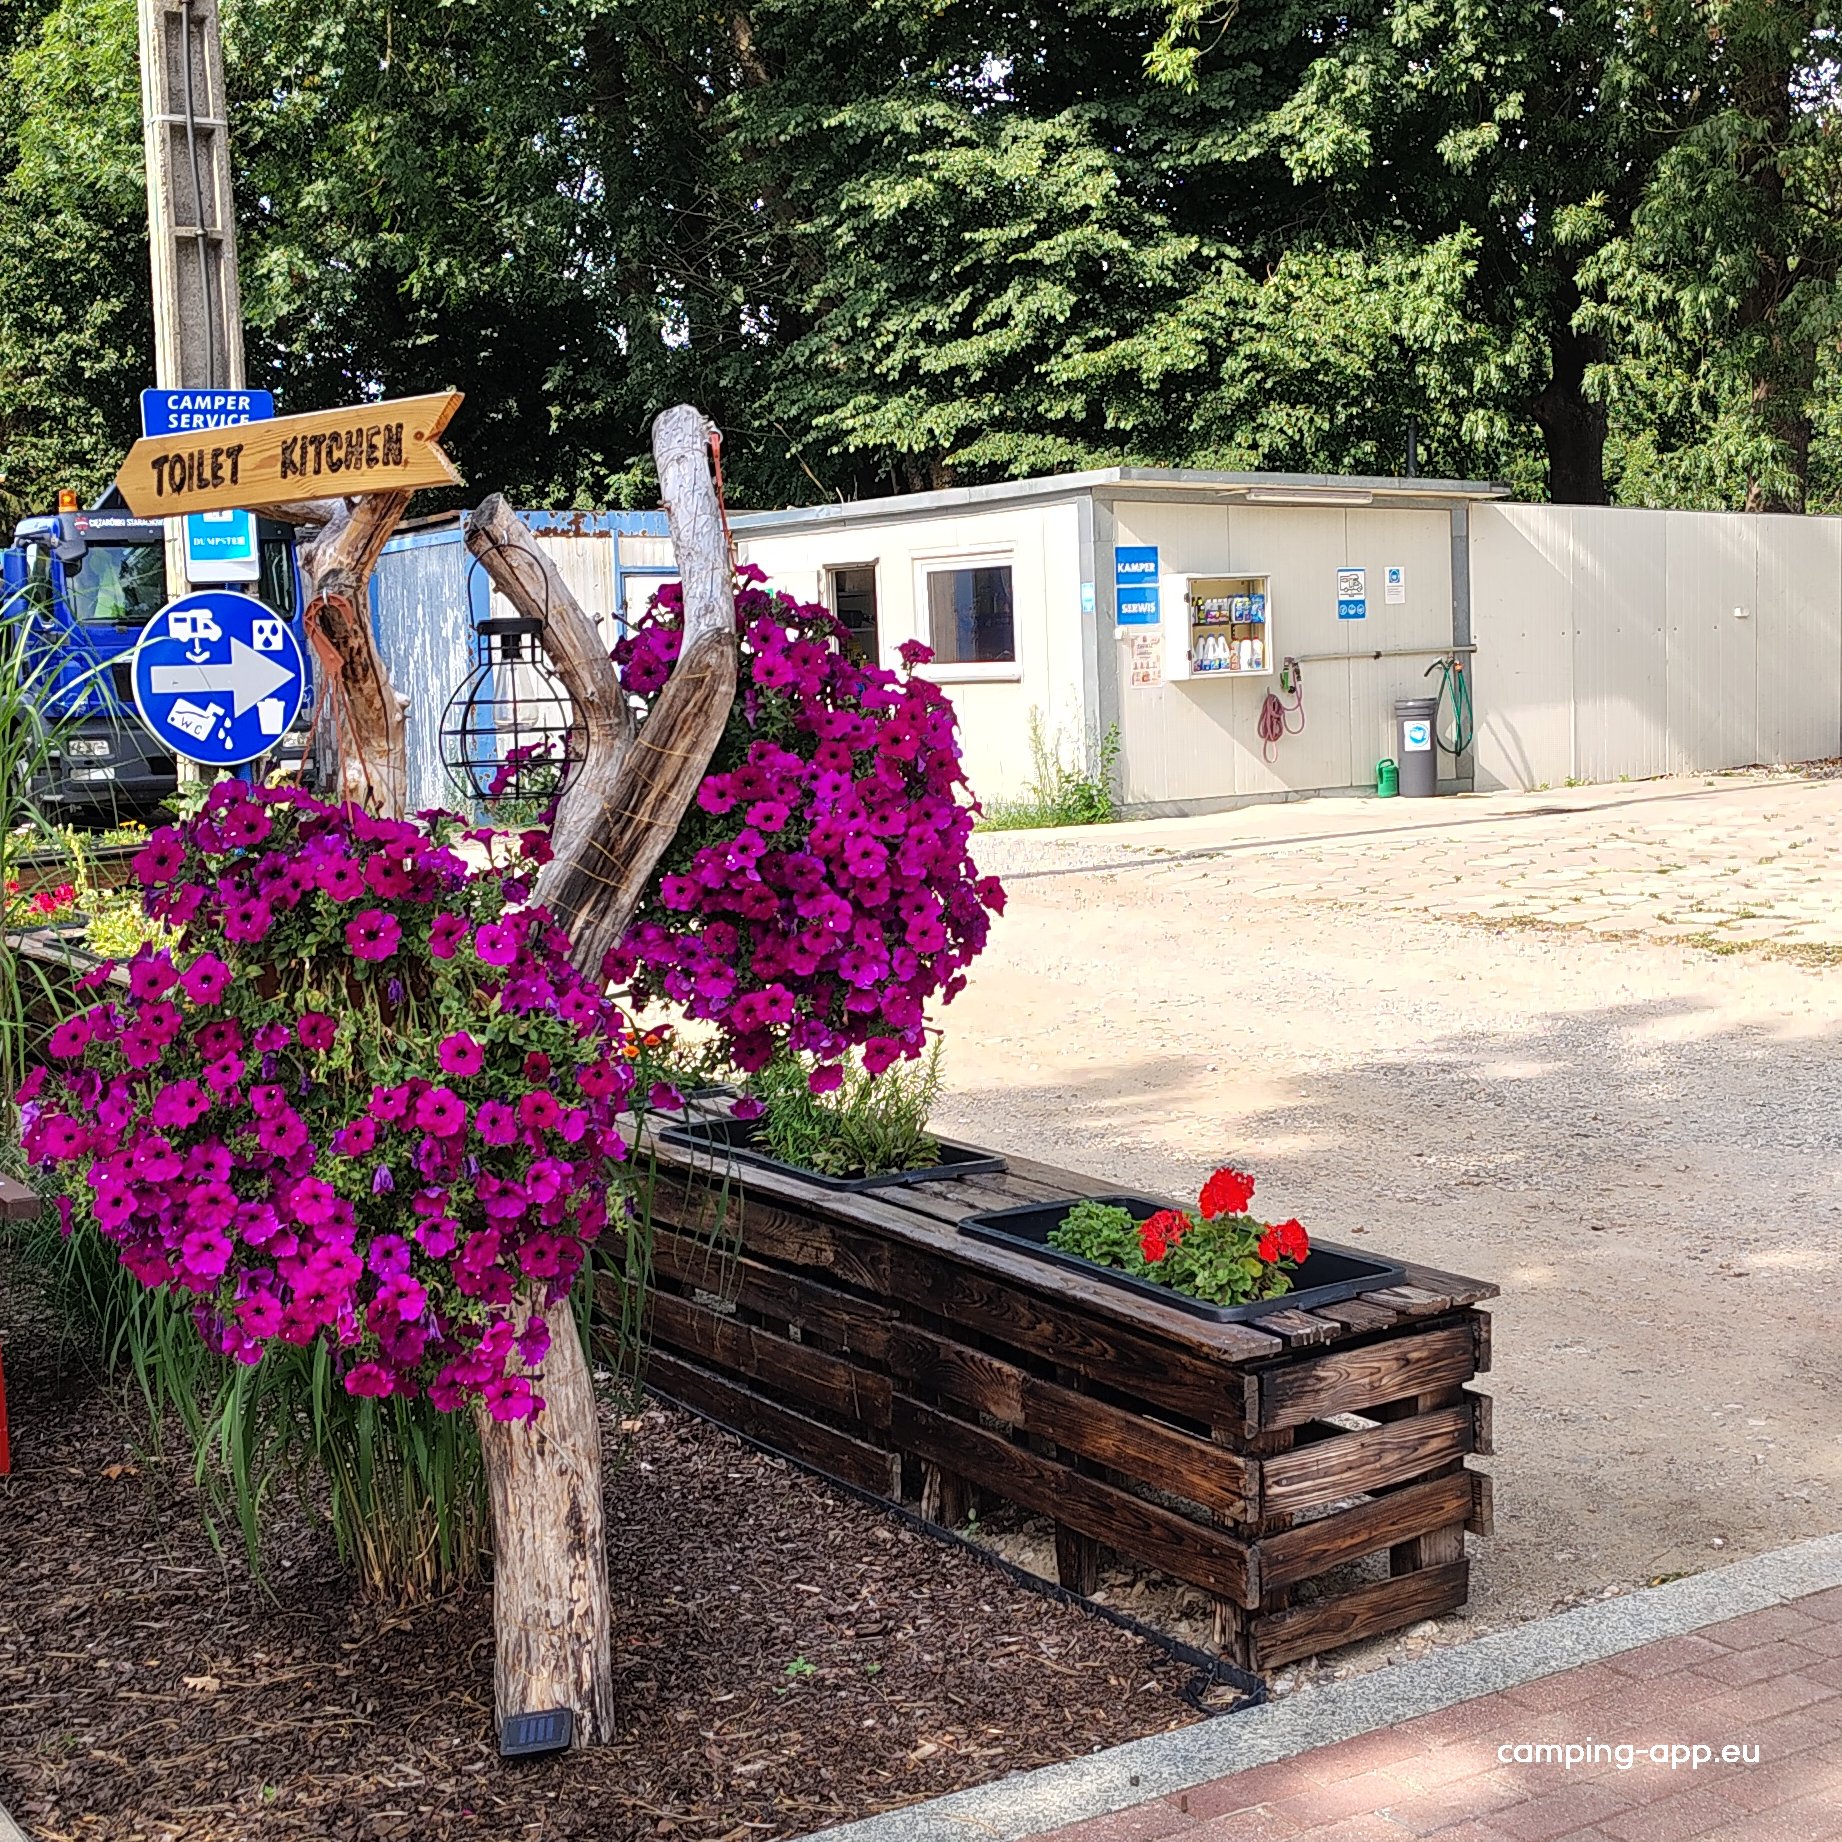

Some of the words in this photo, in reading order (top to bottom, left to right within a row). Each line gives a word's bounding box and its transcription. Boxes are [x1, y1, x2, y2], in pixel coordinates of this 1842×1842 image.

[167, 394, 251, 411] CAMPER
[167, 413, 250, 429] SERVICE
[151, 443, 244, 497] TOILET
[280, 422, 404, 480] KITCHEN
[1117, 562, 1156, 574] KAMPER
[1121, 602, 1156, 614] SERWIS
